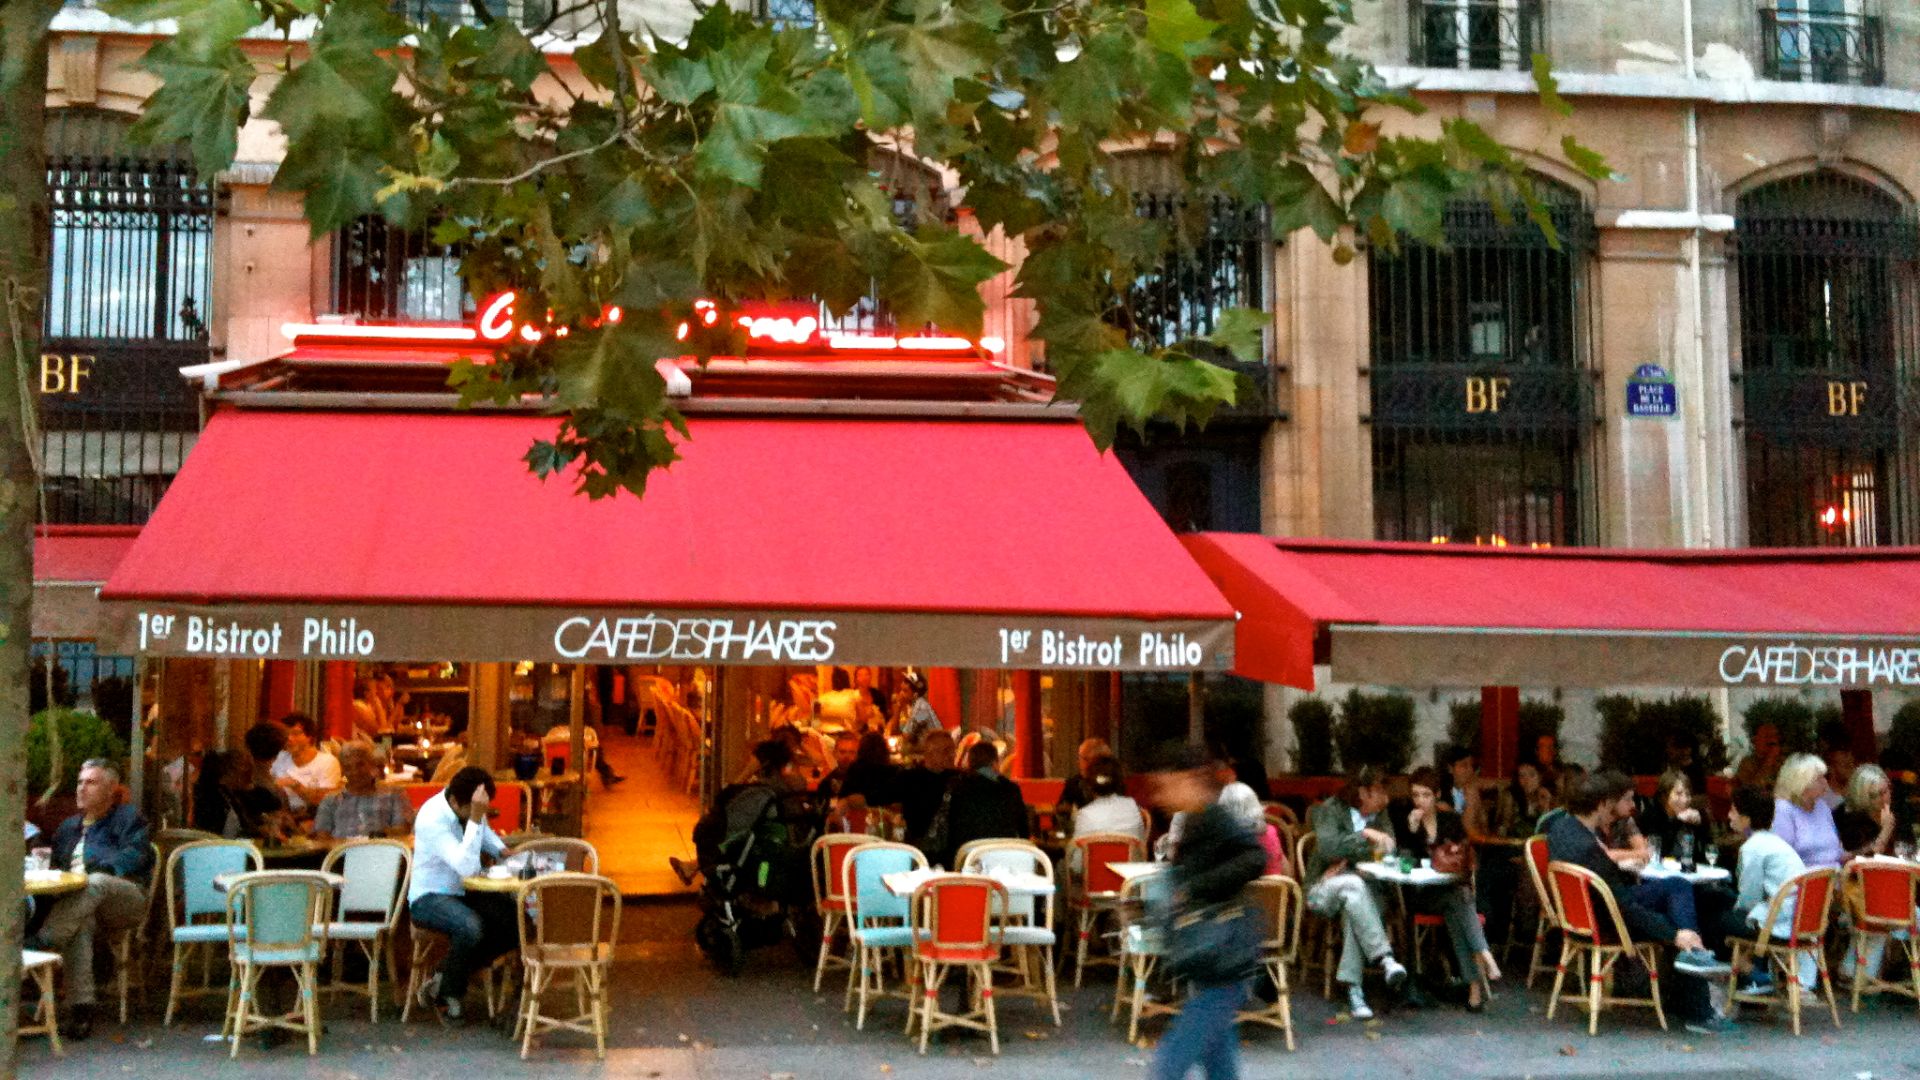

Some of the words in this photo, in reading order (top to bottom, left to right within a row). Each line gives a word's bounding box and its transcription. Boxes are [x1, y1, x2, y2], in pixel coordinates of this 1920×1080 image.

[41, 354, 96, 394] BF
[1638, 385, 1664, 394] PLACE
[1466, 377, 1511, 413] BF
[1633, 403, 1671, 413] BASTILLE
[1640, 394, 1649, 403] DE
[1653, 394, 1663, 404] LA
[1828, 381, 1867, 416] BF
[138, 612, 175, 650] 1er
[186, 615, 282, 654] Bistrot
[303, 617, 374, 655] Philo
[999, 628, 1031, 664] 1er
[1041, 630, 1122, 666] Bistrot
[1140, 631, 1202, 666] Philo
